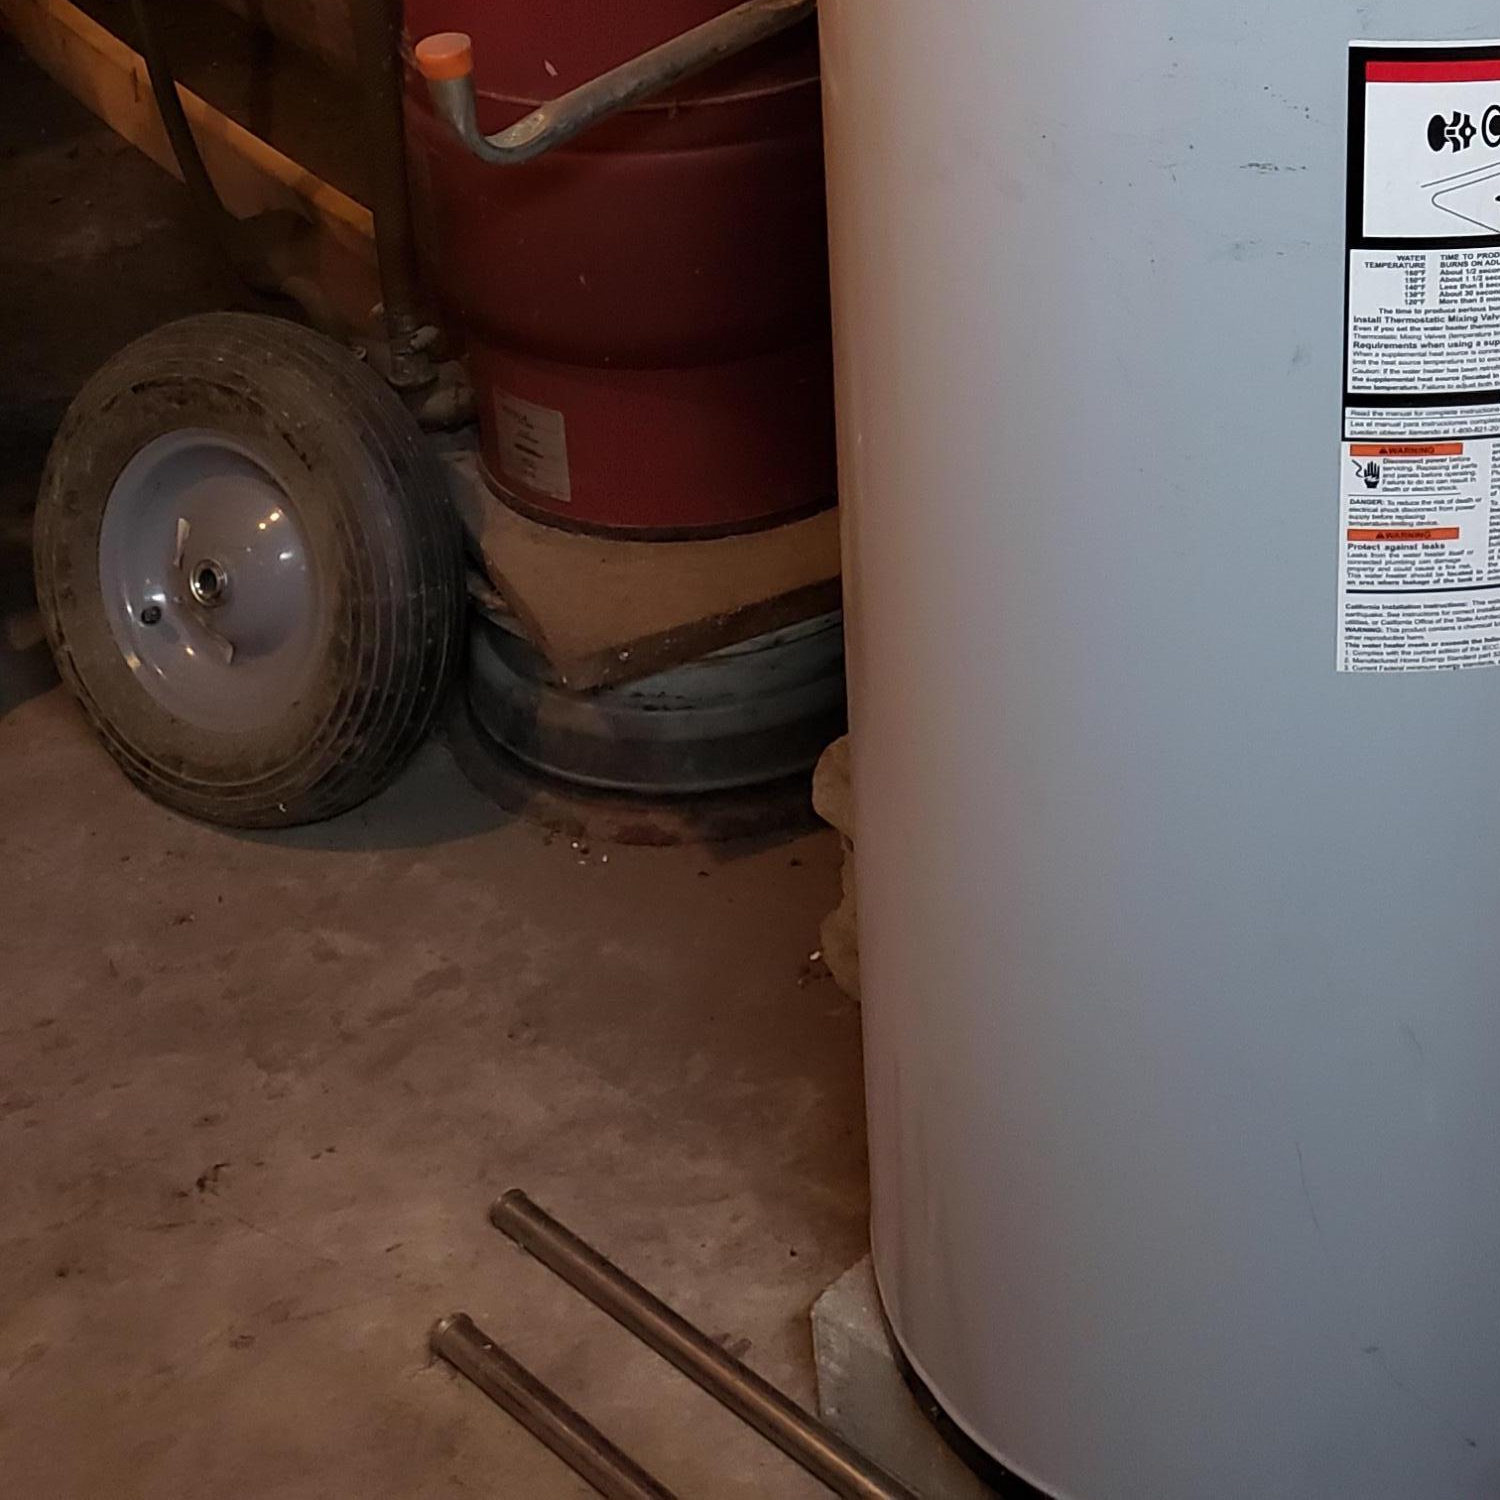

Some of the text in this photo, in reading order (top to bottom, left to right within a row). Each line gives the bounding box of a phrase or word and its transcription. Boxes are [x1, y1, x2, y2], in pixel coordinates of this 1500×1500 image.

[1365, 261, 1426, 269] TEMPERATURE
[1384, 315, 1445, 323] Thermostatic
[1448, 314, 1478, 323] Mixing
[1352, 341, 1418, 350] Requirements
[1420, 341, 1444, 349] when
[1447, 340, 1473, 349] using
[1385, 543, 1417, 552] against
